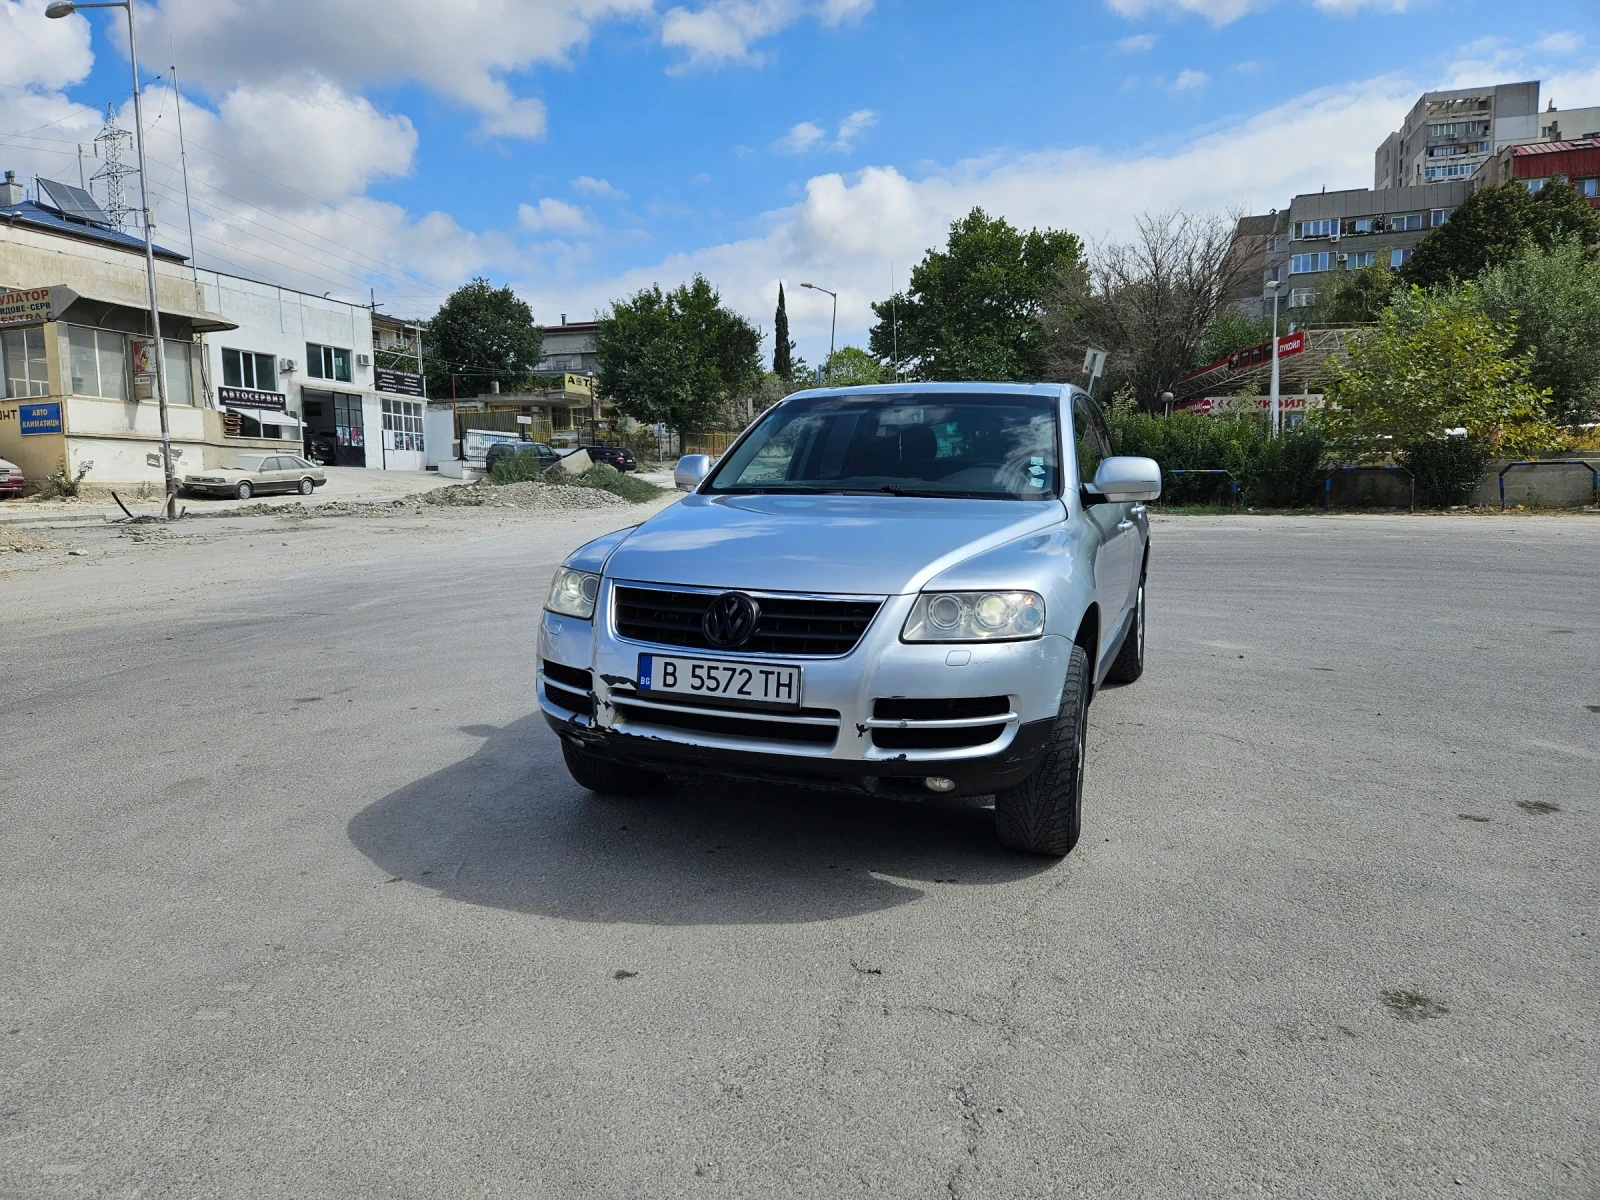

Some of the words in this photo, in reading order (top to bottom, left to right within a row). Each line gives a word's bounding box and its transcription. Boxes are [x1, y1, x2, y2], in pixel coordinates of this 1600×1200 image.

[222, 390, 284, 403] АВТОСЕРВИЗ
[32, 408, 48, 416] АВТО
[22, 420, 60, 429] КЛИМАТИЦИ
[640, 676, 650, 685] BG
[690, 664, 753, 696] 5572
